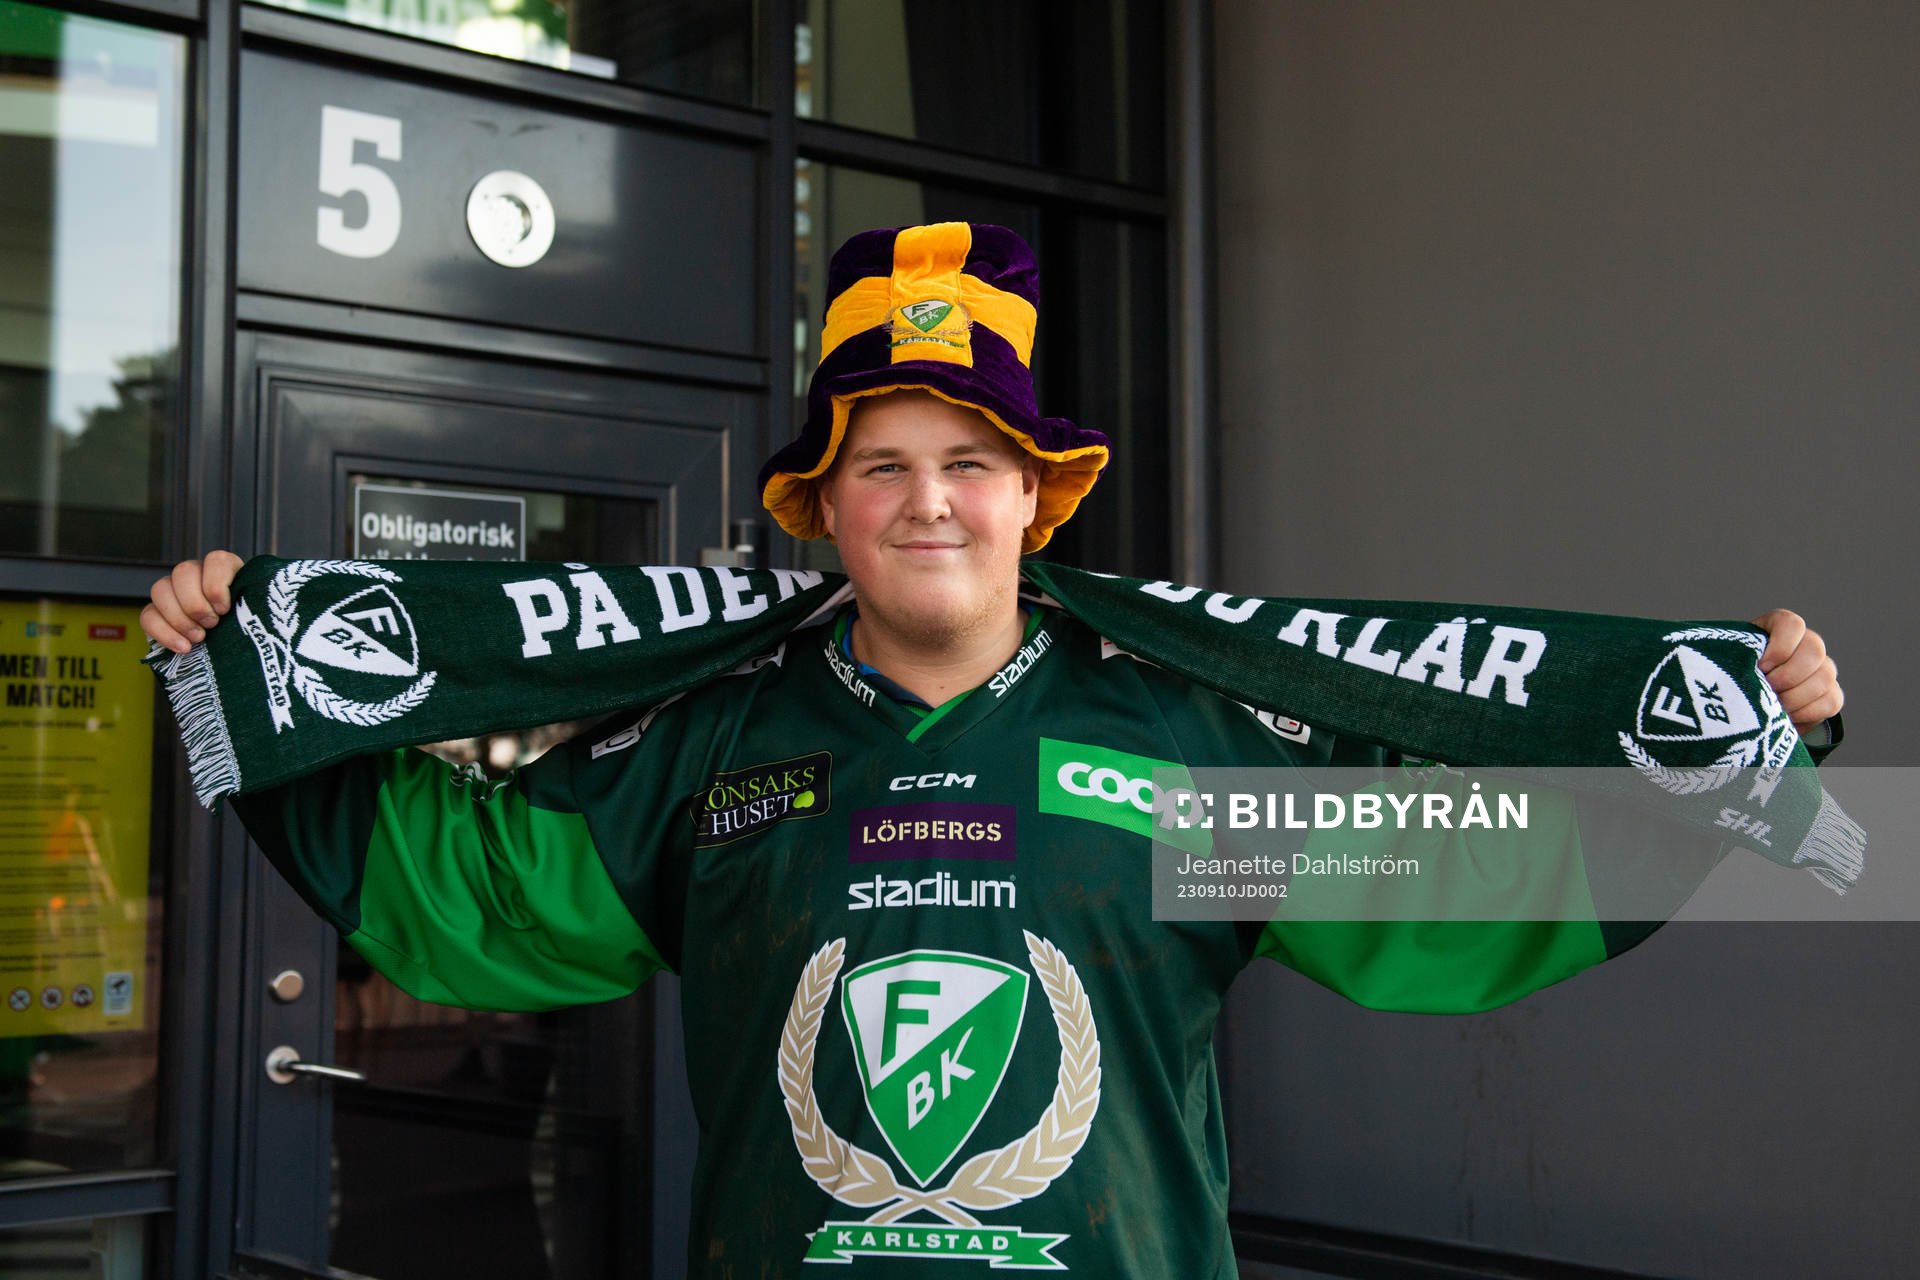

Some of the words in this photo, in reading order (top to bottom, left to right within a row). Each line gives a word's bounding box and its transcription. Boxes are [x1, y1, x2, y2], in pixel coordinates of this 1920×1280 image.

[317, 105, 402, 259] 5
[911, 303, 929, 316] F
[919, 310, 939, 325] BK
[361, 511, 515, 548] Obligatorisk
[502, 562, 641, 659] PÅ
[246, 618, 289, 708] KARLSTAD
[320, 628, 379, 659] BK
[988, 629, 1053, 699] stadium
[56, 655, 103, 680] TILL
[824, 639, 876, 708] stadium
[6, 683, 95, 709] MATCH!
[1694, 679, 1730, 725] BK
[704, 766, 815, 811] ÖNSAKS
[889, 773, 977, 792] CCM
[1057, 761, 1204, 831] coop
[711, 792, 796, 836] HUSET
[862, 819, 1003, 845] LÖFBERGS
[848, 871, 1017, 911] stadium
[880, 980, 941, 1070] F
[907, 1026, 976, 1131] BK
[837, 1230, 1009, 1251] KARLSTAD
